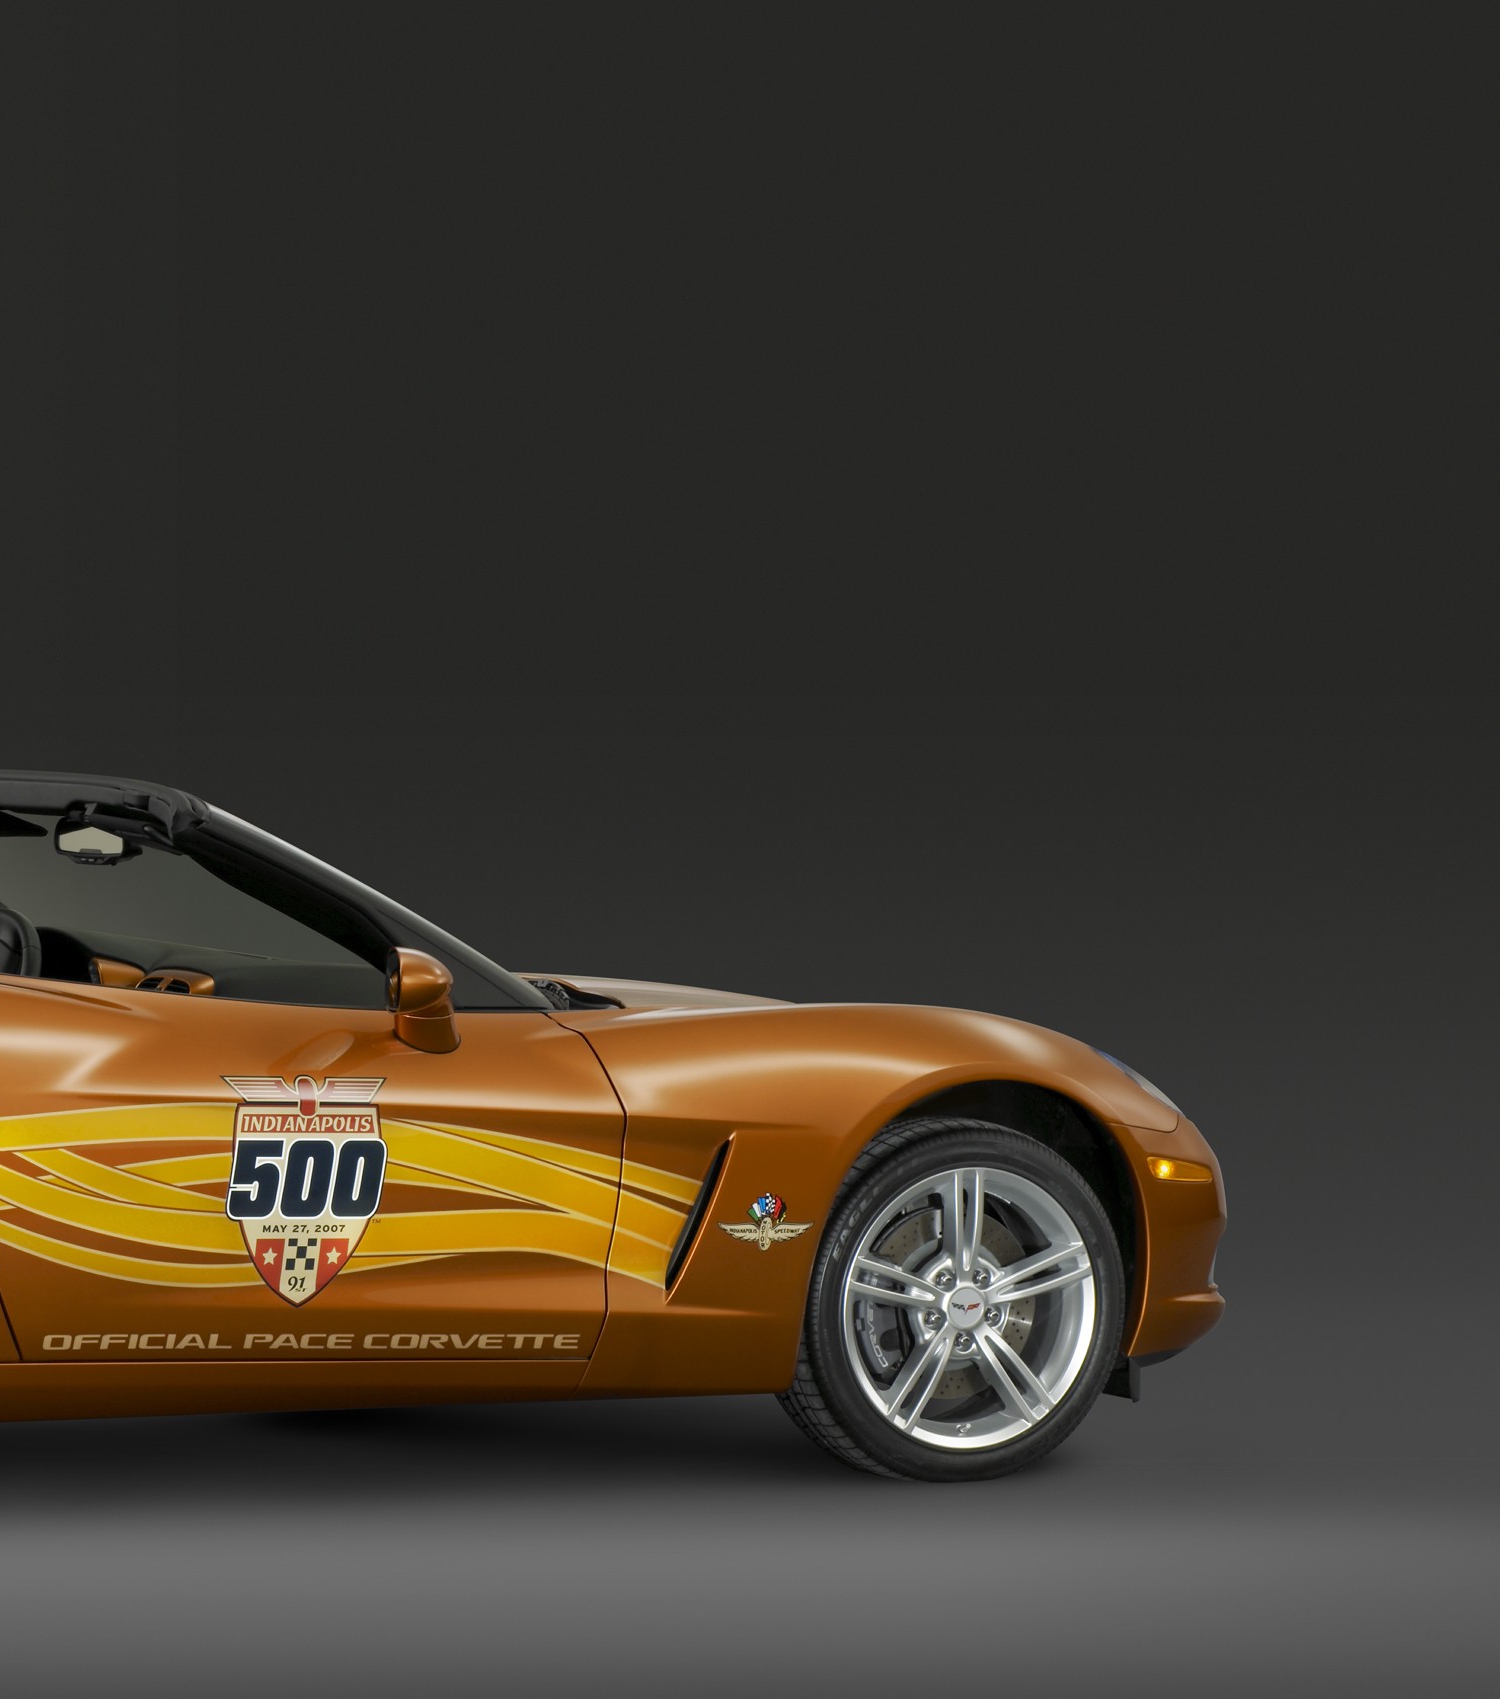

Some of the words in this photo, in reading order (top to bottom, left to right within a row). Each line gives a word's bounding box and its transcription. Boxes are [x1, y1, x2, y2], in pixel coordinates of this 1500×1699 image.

[243, 1115, 372, 1132] INDIANAPOLIS
[226, 1138, 388, 1221] 500
[262, 1225, 287, 1233] MAY
[292, 1225, 309, 1234] 27,
[314, 1225, 346, 1233] 2007
[760, 1220, 768, 1248] MOTOR
[288, 1275, 306, 1292] 91
[42, 1333, 233, 1351] OFFICIAL
[243, 1333, 353, 1350] PACE
[363, 1333, 581, 1350] CORVETTE
